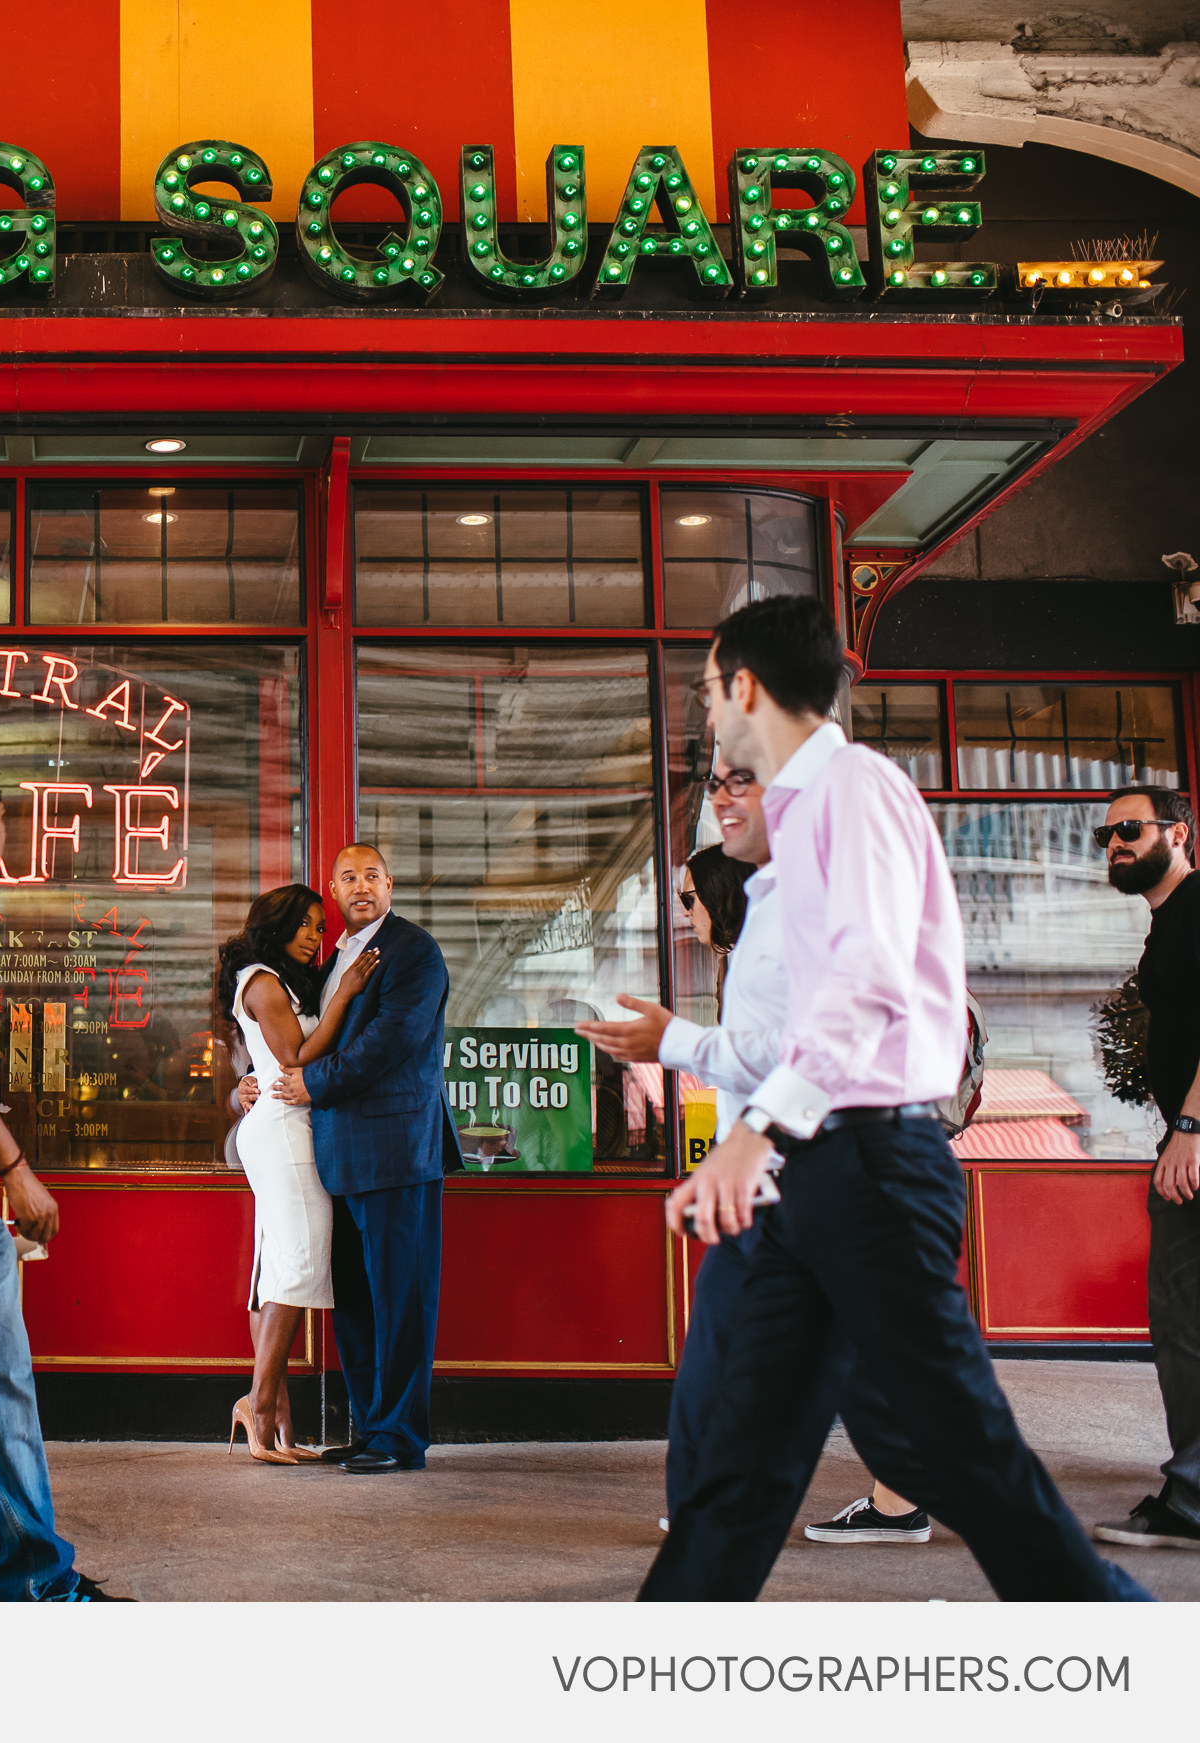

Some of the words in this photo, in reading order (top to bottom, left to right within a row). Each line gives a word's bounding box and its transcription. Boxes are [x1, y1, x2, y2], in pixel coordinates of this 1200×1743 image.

[150, 139, 1002, 306] SQUARE
[14, 954, 47, 968] 7:00AM
[37, 970, 62, 984] FROM
[459, 1036, 579, 1073] Serving
[445, 1081, 477, 1111] up
[484, 1076, 521, 1108] To
[529, 1076, 569, 1109] Go
[74, 1122, 108, 1137] 3:00PM
